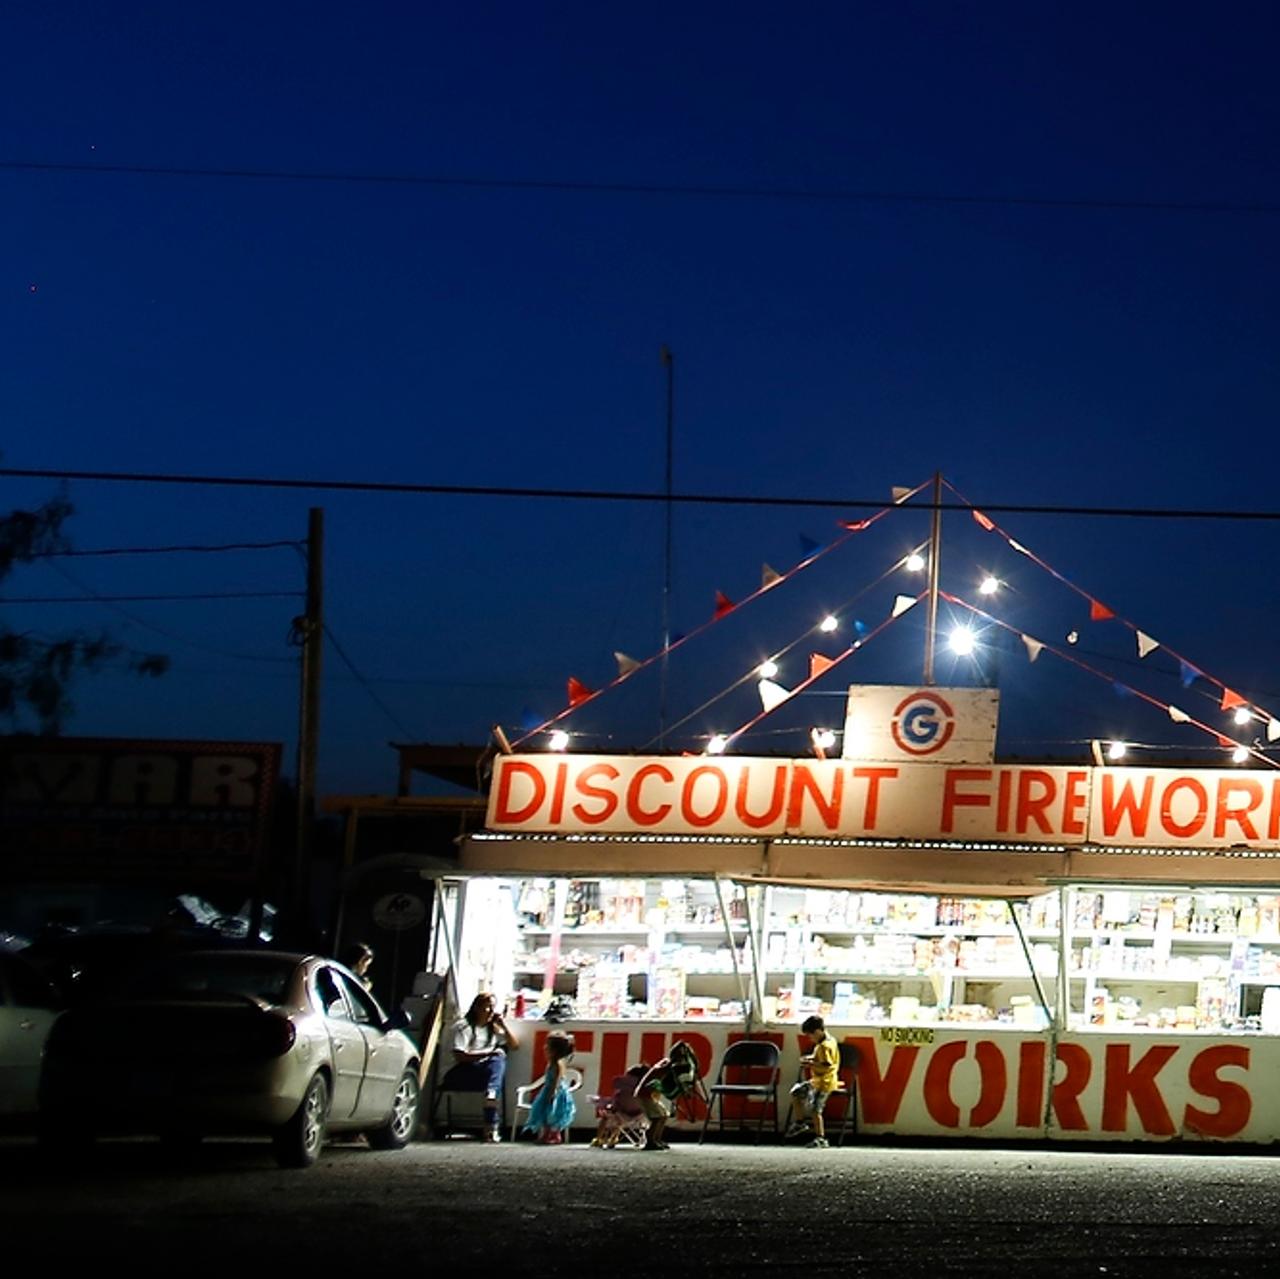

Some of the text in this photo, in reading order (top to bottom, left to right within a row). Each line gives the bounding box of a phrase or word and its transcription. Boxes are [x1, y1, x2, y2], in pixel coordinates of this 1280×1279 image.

[493, 762, 898, 830] DISCOUNT
[881, 1027, 934, 1043] NO SMOKING
